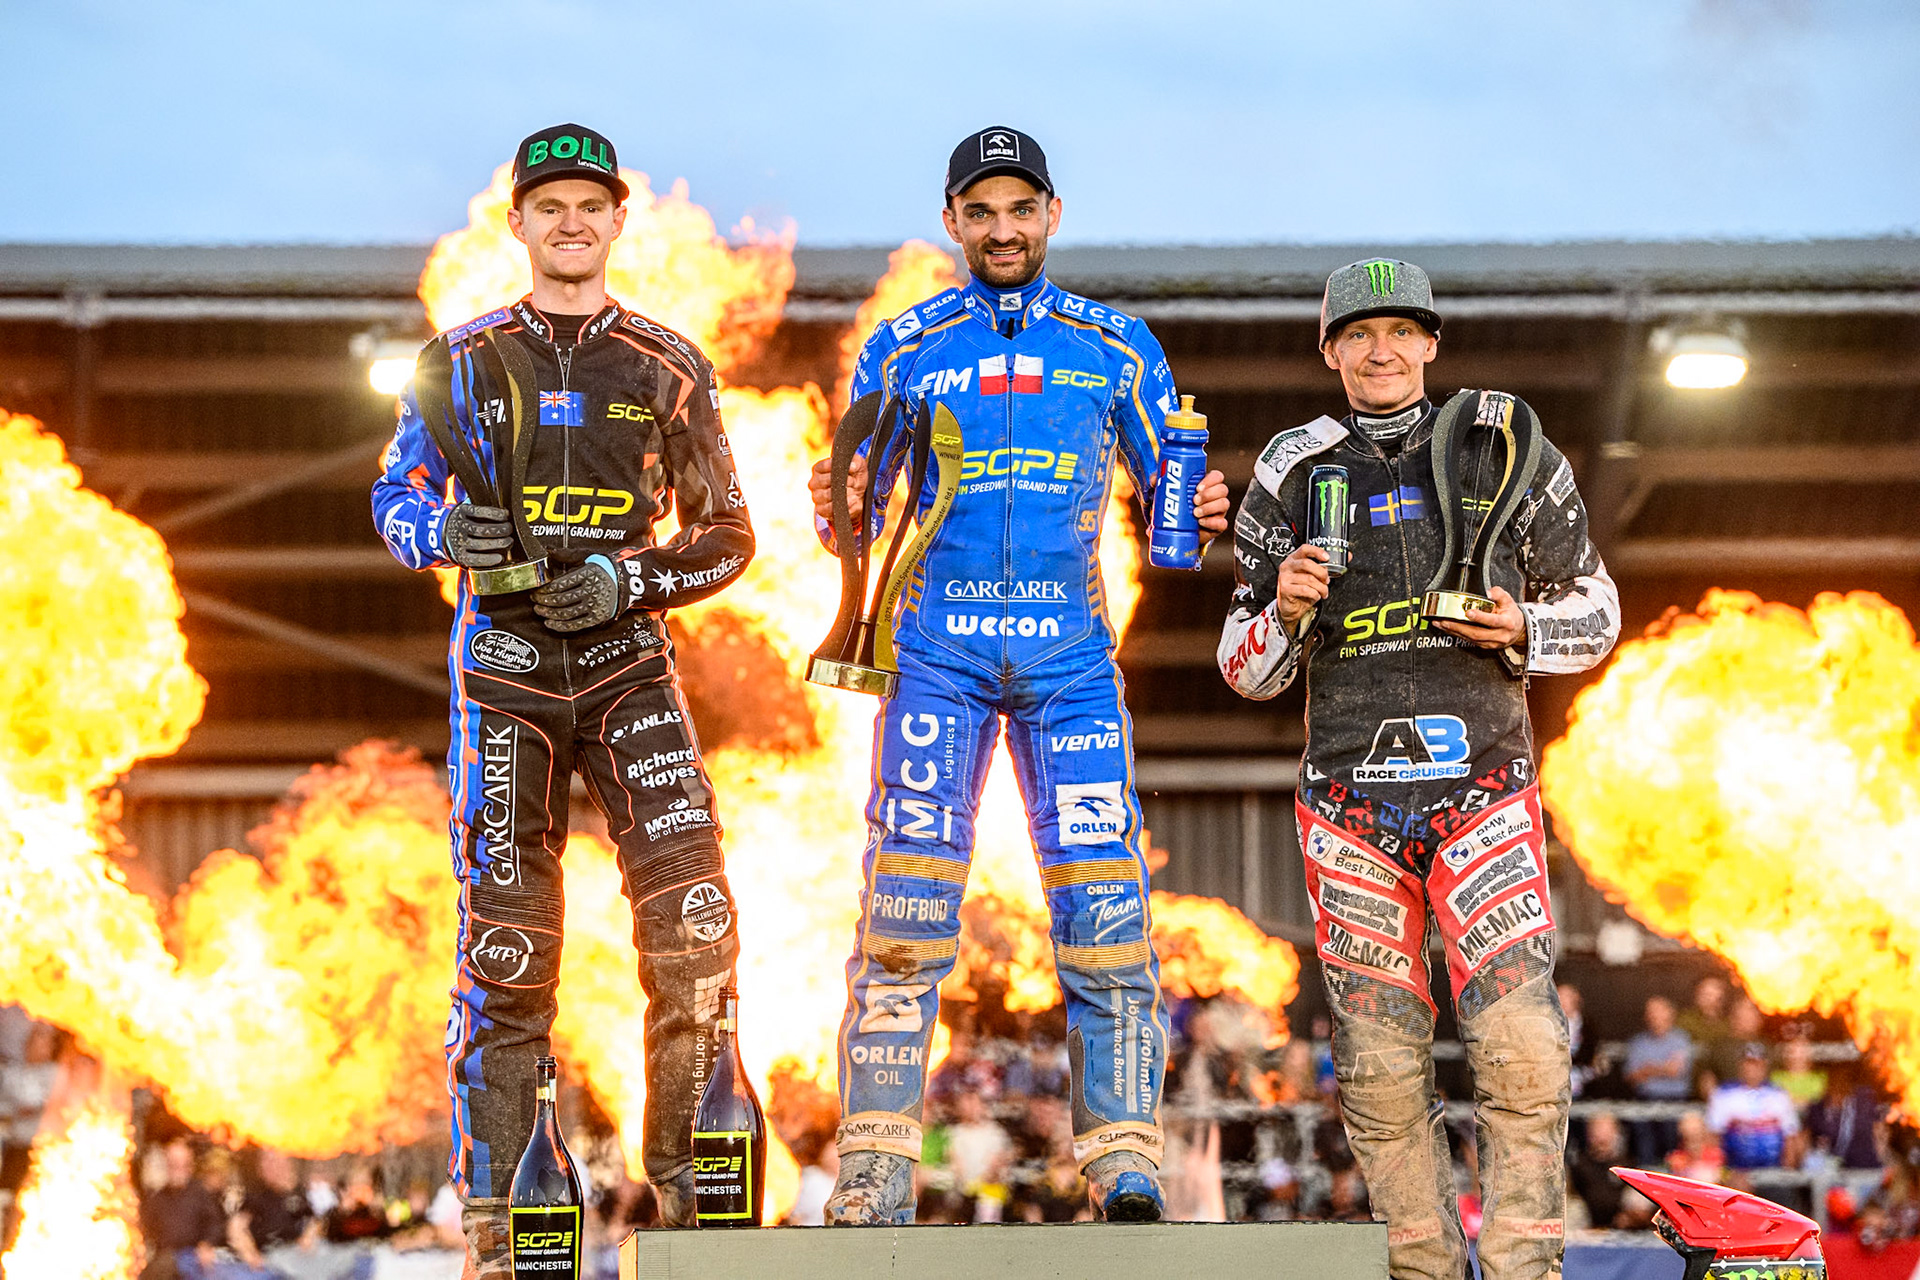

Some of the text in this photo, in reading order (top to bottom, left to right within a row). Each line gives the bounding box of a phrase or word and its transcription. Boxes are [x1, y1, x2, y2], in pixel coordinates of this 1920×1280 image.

[527, 135, 613, 171] BOLL
[986, 148, 1014, 156] ORLEN
[922, 293, 957, 315] ORLEN
[925, 310, 940, 320] OIL
[909, 367, 974, 399] FIM
[1051, 369, 1108, 390] SGP
[606, 403, 655, 423] SGP
[932, 433, 962, 447] SGP
[938, 450, 962, 461] WINNER
[960, 448, 1056, 480] SGP
[1275, 440, 1323, 474] CARS
[969, 480, 1018, 494] SPEEDWAY
[1017, 480, 1046, 493] GRAND
[1047, 484, 1069, 495] PRIX
[1163, 459, 1183, 529] verva
[522, 485, 635, 525] SGP
[529, 524, 627, 540] EDWAY GRAND PRIX
[1078, 510, 1098, 532] 95
[885, 605, 893, 622] 2025
[900, 551, 921, 580] Speedway
[916, 541, 925, 552] GP
[925, 509, 947, 540] Manchester
[944, 492, 953, 501] Rd
[679, 555, 745, 588] burnside
[944, 579, 1068, 600] GARCAREK
[1343, 596, 1429, 642] SG
[475, 642, 532, 668] Joe Hughes
[577, 639, 631, 666] EASTERN
[588, 645, 628, 668] POINT
[1340, 646, 1358, 659] FIM
[1359, 639, 1412, 656] SPEEDWAY
[1416, 636, 1453, 648] GRAND
[479, 652, 522, 671] International
[631, 711, 683, 734] ANLAS
[1051, 728, 1120, 752] verva
[1361, 715, 1472, 766] AB
[627, 746, 696, 779] Richard
[943, 727, 955, 779] Logistics
[640, 766, 698, 788] Hayes
[901, 712, 940, 840] MCG
[1356, 766, 1470, 780] RACE CRUISERS
[483, 725, 516, 887] GARCAREK
[644, 809, 712, 835] MOTOREX
[649, 822, 717, 842] Oil of Switzerland
[1069, 822, 1117, 835] ORLEN
[1481, 820, 1531, 847] Best Auto
[1334, 857, 1394, 885] Best Auto
[1454, 847, 1528, 911] NICKSON
[1086, 884, 1124, 896] ORLEN
[872, 893, 948, 922] PROFBUD
[1089, 896, 1140, 928] Team
[692, 1028, 707, 1078] Flooring
[850, 1045, 923, 1066] ORLEN
[1110, 1004, 1125, 1098] nsurance Broker
[874, 1071, 904, 1086] OIL
[1140, 1026, 1154, 1114] Grohmann
[845, 1122, 911, 1136] GARCAREK
[694, 1156, 731, 1172] SGP
[695, 1184, 742, 1195] ANCHESTER
[516, 1232, 563, 1248] SGP
[515, 1261, 573, 1271] MANCHESTER
